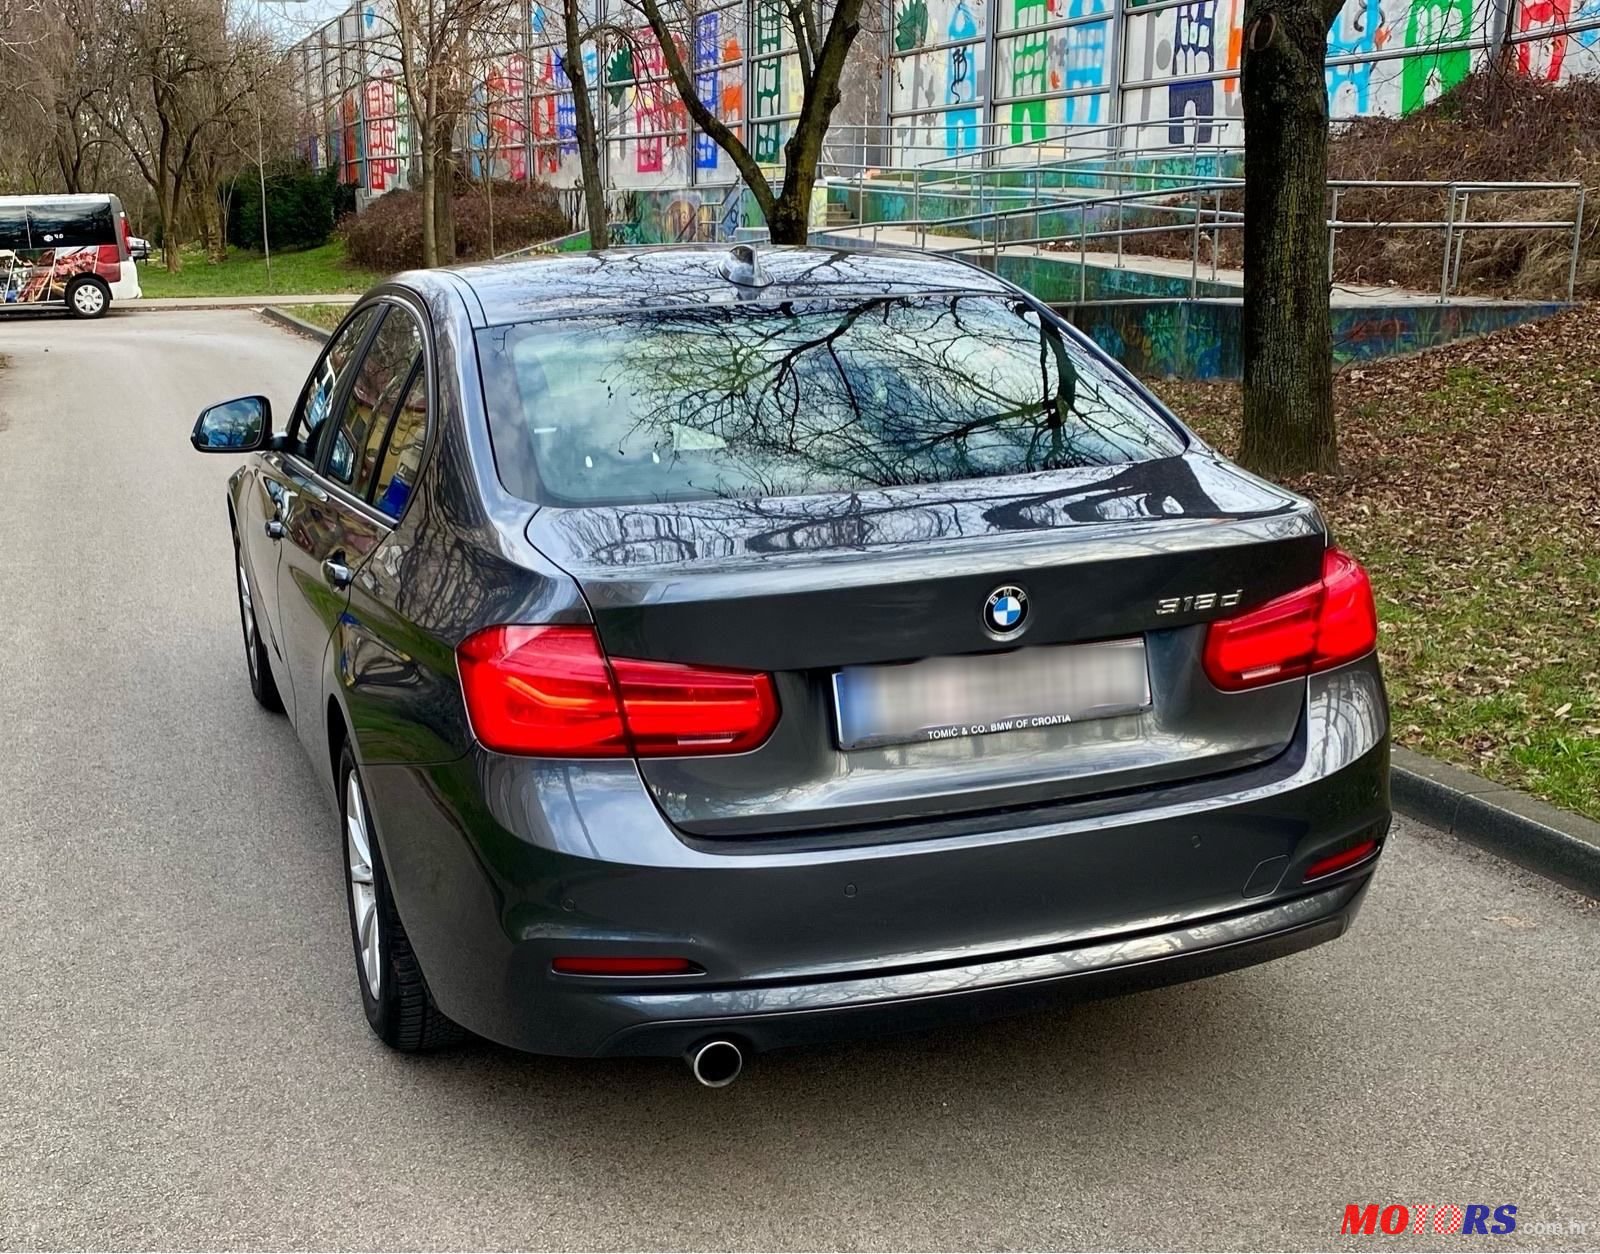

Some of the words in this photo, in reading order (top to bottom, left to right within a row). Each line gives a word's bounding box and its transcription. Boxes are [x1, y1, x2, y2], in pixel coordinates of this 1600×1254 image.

[989, 588, 1027, 605] BMW
[928, 727, 958, 740] TOMIĆ
[961, 727, 968, 735] &
[971, 724, 988, 734] CO.
[990, 721, 1013, 732] BMW
[1015, 719, 1029, 729] OF
[1031, 714, 1071, 726] CROATIA
